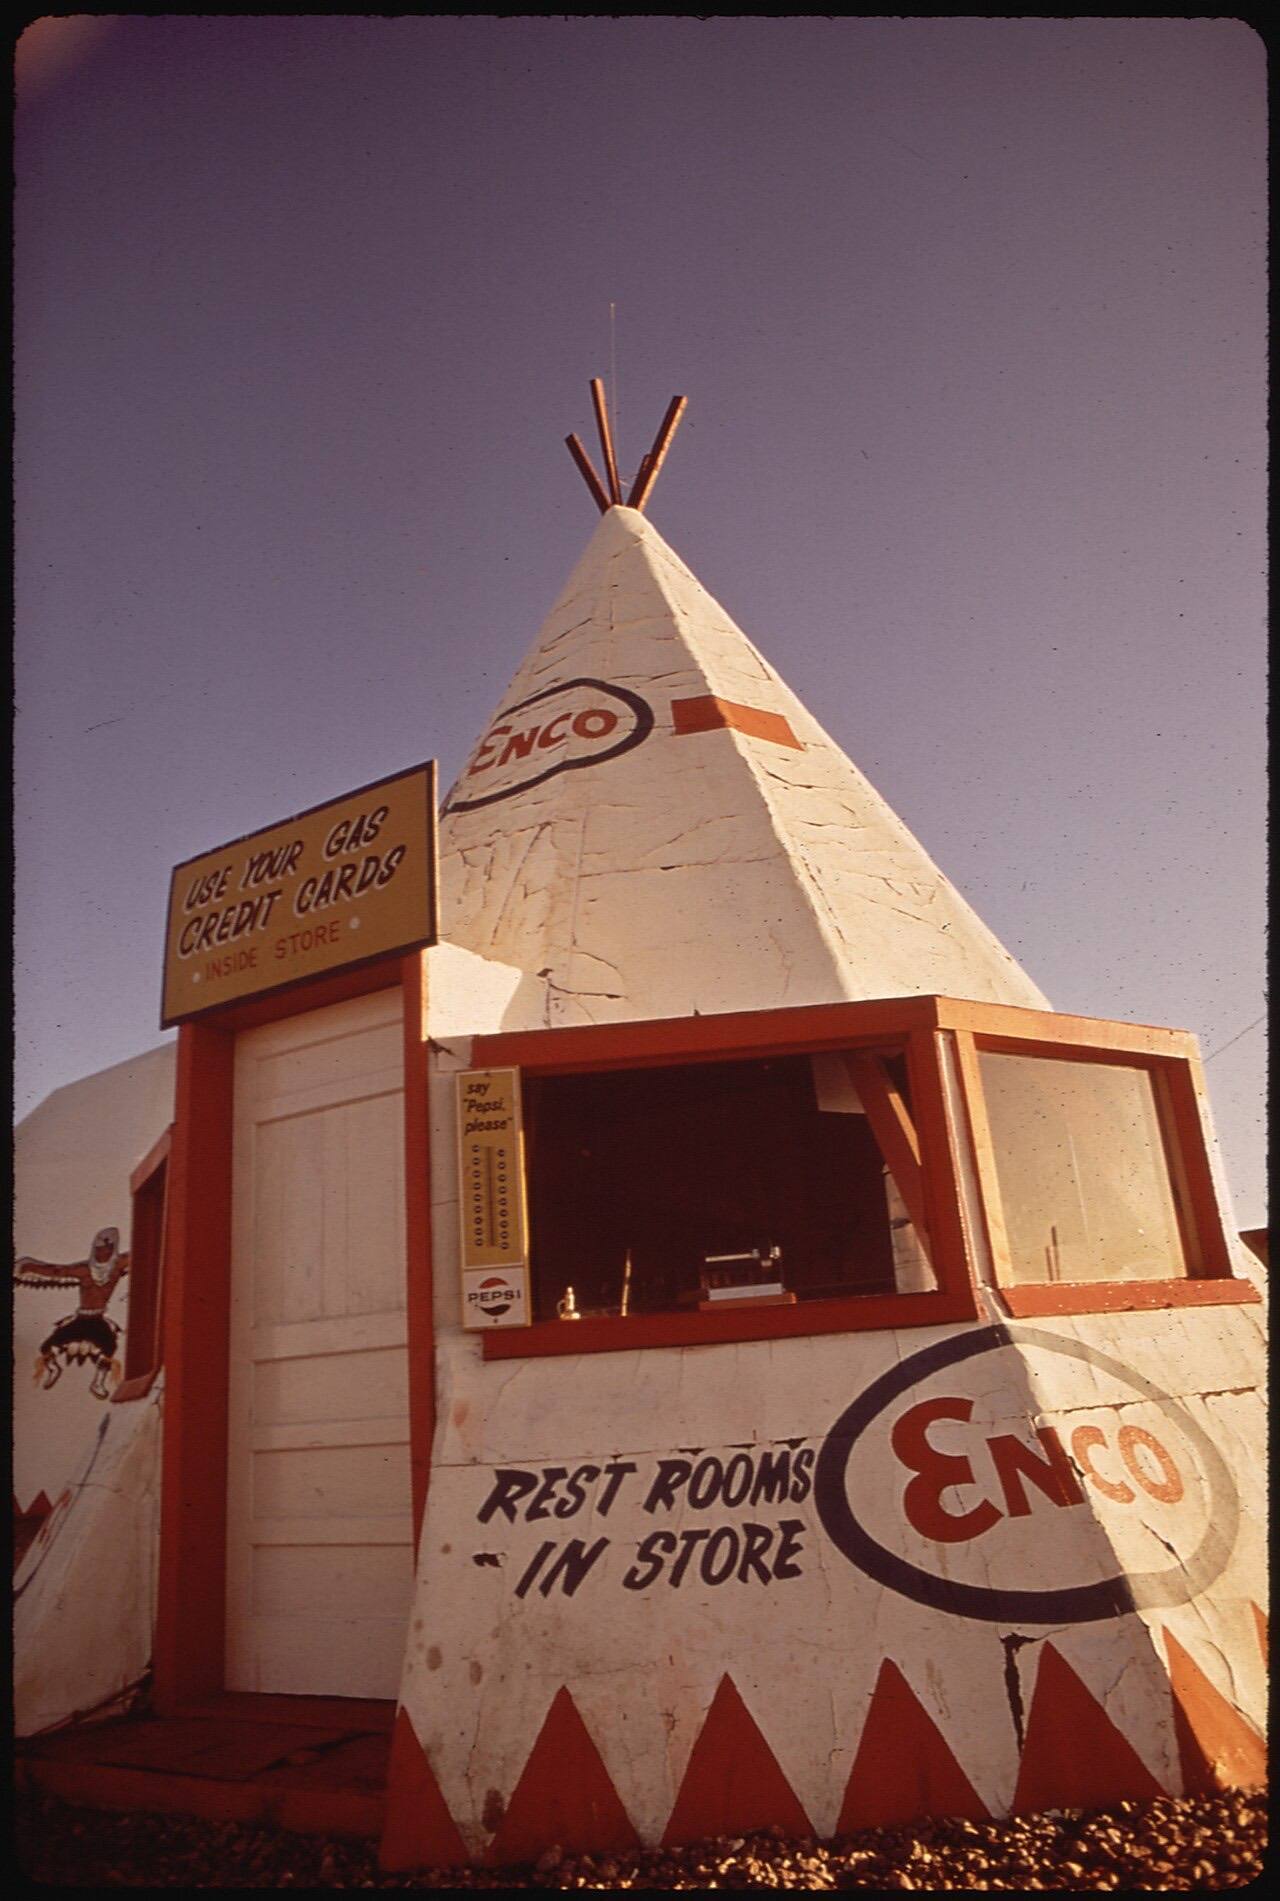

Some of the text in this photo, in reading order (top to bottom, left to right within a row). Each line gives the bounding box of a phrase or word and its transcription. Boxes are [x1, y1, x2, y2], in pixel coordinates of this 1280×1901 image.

[467, 709, 618, 776] ENCO
[184, 805, 389, 913] USE YOUR GAS
[178, 844, 406, 957] CREDIT CARDS
[206, 920, 340, 982] INSIDE STORE
[467, 1082, 490, 1096] say
[468, 1289, 521, 1302] PEPSI
[476, 1448, 815, 1524] REST ROOMS
[890, 1396, 1185, 1544] ENCO
[514, 1518, 807, 1600] IN STORE
